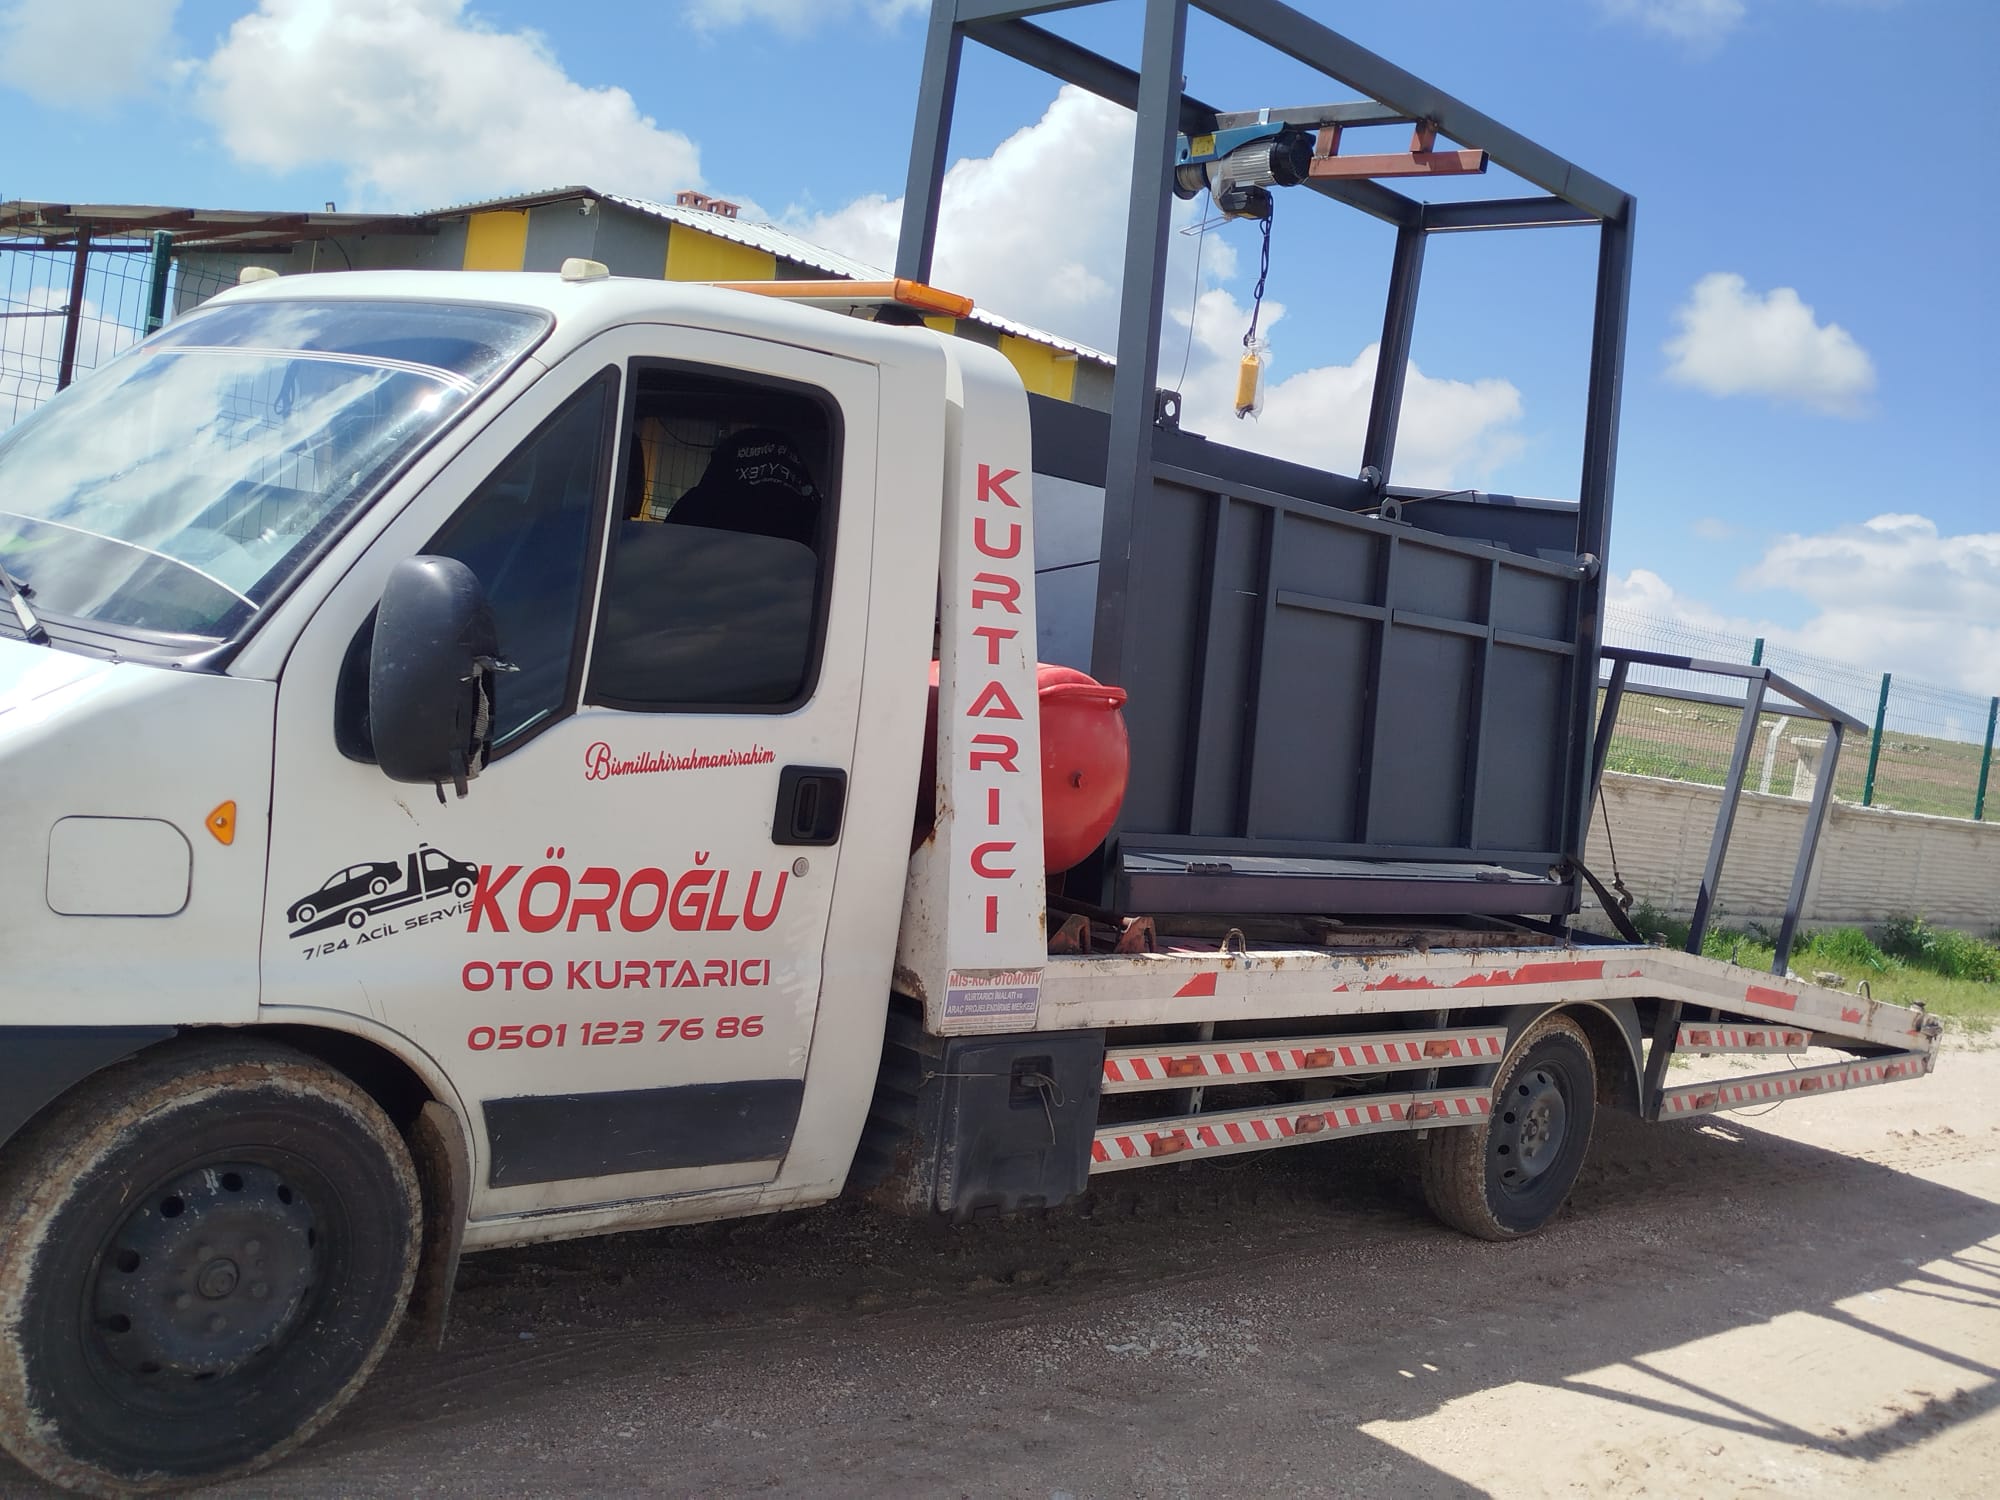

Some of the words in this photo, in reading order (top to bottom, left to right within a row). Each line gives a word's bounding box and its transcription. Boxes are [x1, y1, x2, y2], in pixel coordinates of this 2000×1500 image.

[966, 463, 1023, 934] KURTARICI
[585, 741, 776, 781] Bismillahirrahmanirrahim
[467, 846, 789, 933] KÖROĞLU
[302, 938, 350, 961] 7/24
[356, 923, 400, 945] ACİL
[404, 900, 474, 930] SERVİS
[462, 960, 553, 992] OTO
[568, 959, 770, 990] KURTARICI
[467, 1023, 567, 1051] 0501
[581, 1020, 645, 1046] 123
[658, 1018, 705, 1042] 76
[715, 1015, 764, 1039] 86
